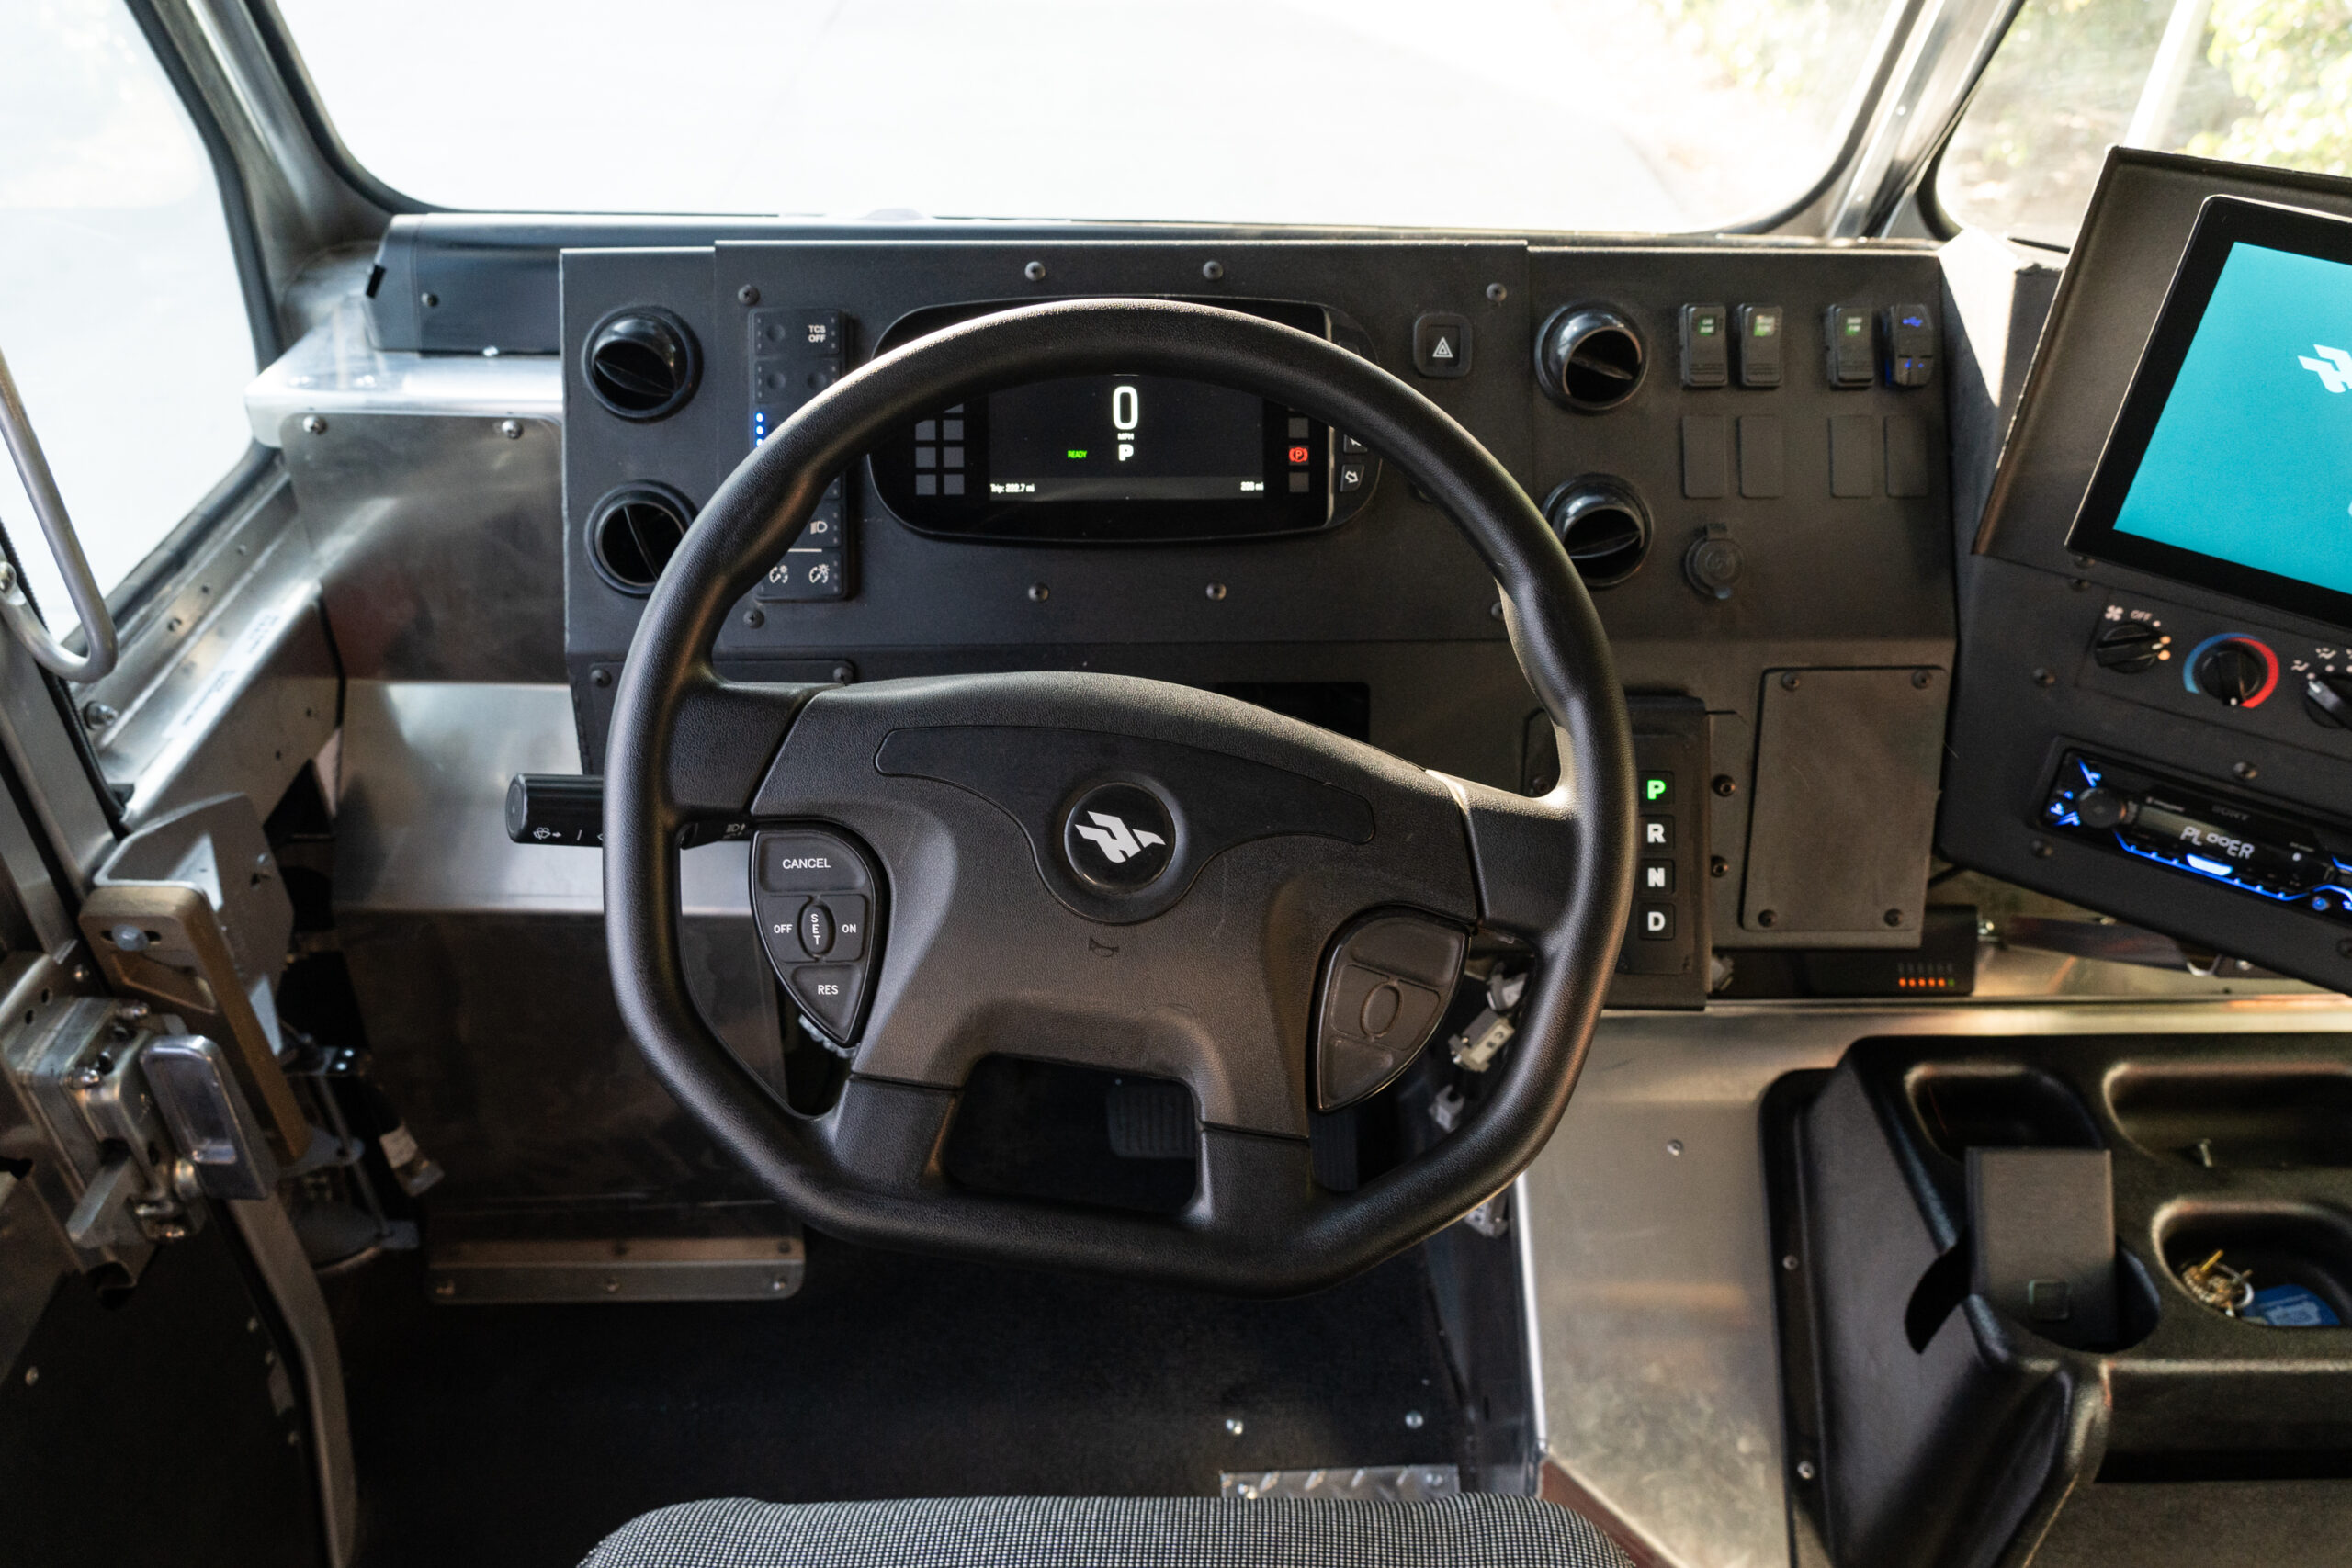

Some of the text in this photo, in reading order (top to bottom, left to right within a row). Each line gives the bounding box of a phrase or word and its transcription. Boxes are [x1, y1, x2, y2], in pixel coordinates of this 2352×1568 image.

[808, 324, 826, 333] TCS
[808, 334, 826, 343] OFF
[1113, 385, 1138, 430] 0
[1117, 433, 1135, 441] MPH
[1067, 450, 1087, 458] READY
[1118, 444, 1134, 461] P
[2131, 609, 2153, 622] OFF
[1647, 779, 1666, 800] P
[1647, 823, 1666, 843] R
[782, 857, 831, 869] CANCEL
[1647, 867, 1665, 887] N
[1647, 911, 1666, 931] D
[774, 913, 857, 945] OFF SET ON
[817, 985, 839, 995] RES
